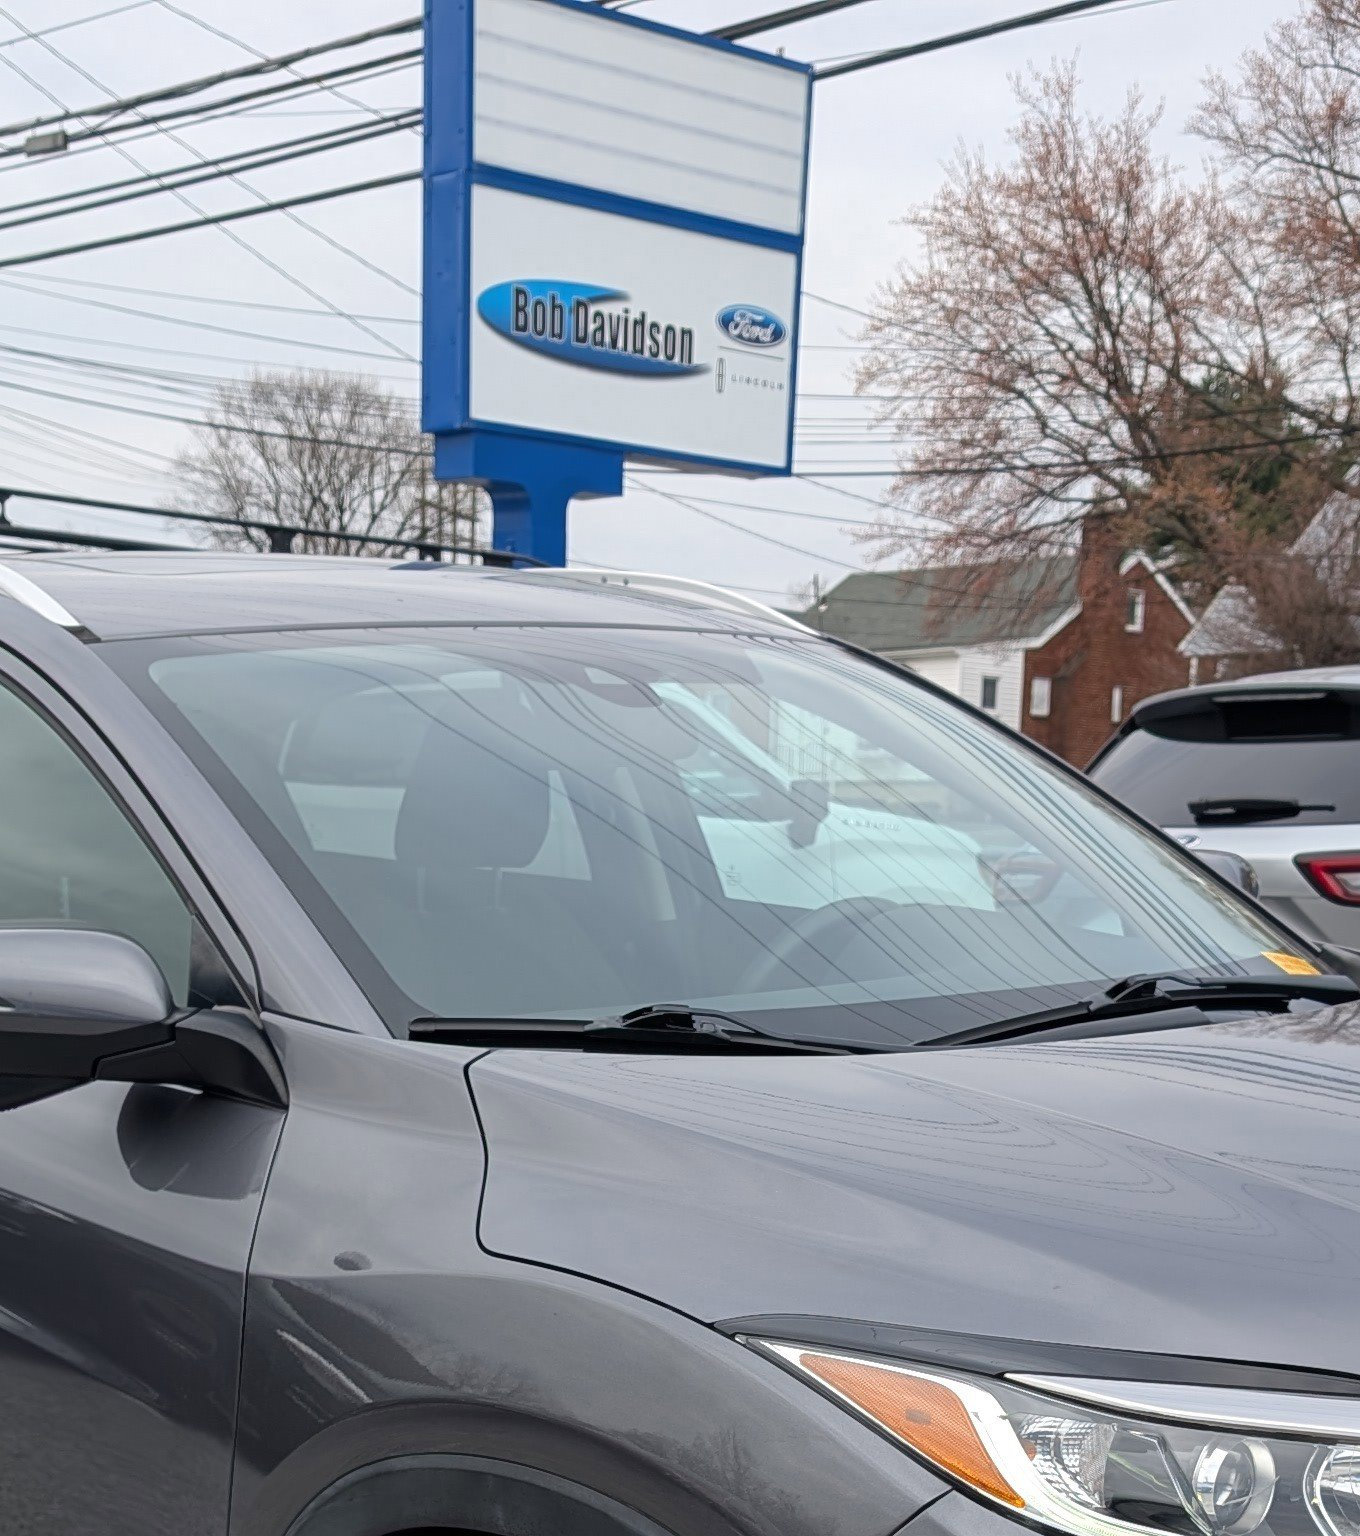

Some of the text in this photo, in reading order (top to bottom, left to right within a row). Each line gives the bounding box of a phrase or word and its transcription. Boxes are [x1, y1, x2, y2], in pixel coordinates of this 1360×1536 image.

[513, 286, 694, 365] Bob Davidson
[728, 309, 777, 342] Ford
